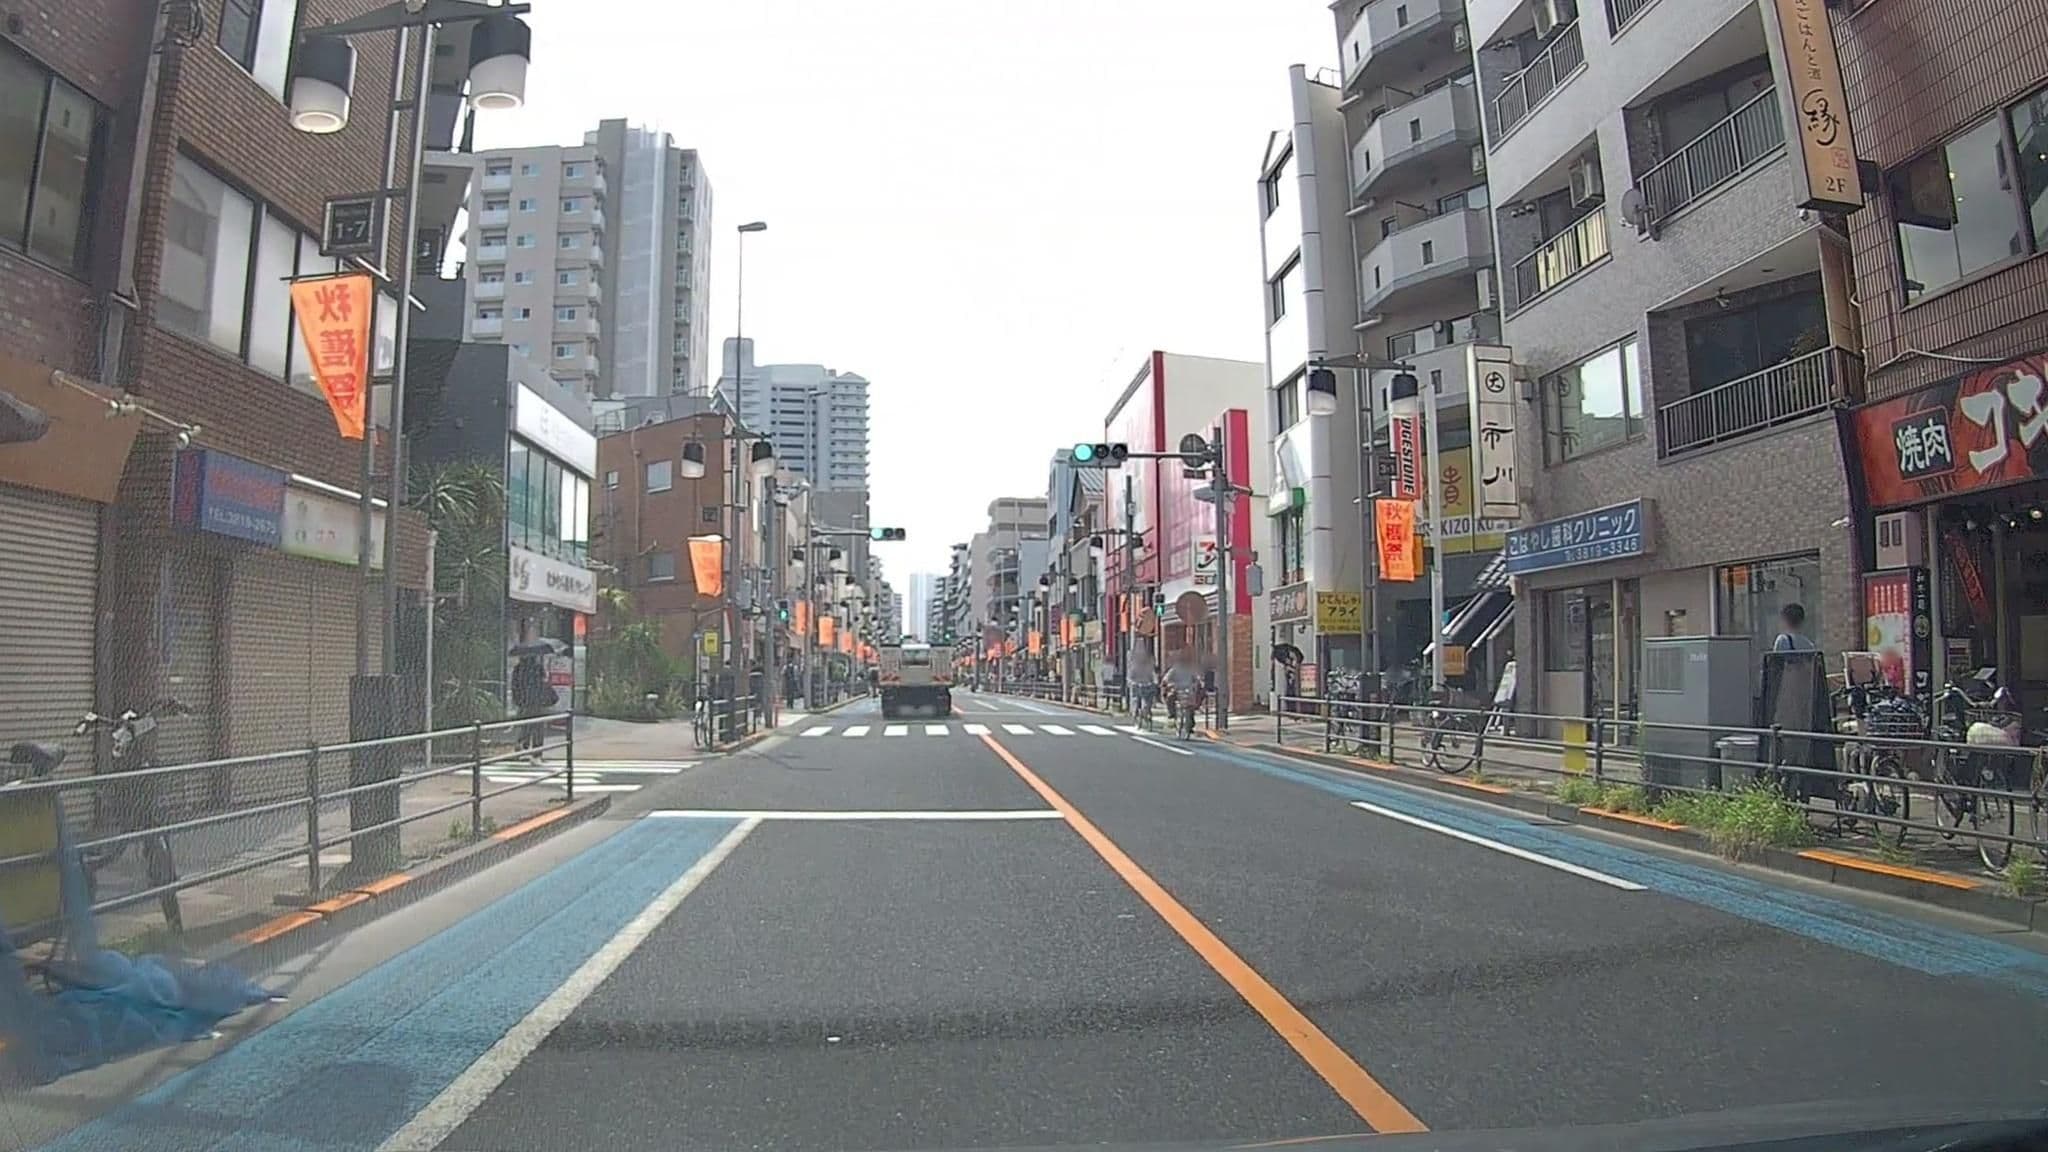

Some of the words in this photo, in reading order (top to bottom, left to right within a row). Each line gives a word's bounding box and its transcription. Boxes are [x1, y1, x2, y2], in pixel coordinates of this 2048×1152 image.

[1825, 176, 1847, 193] 2F
[336, 220, 367, 242] 1-7
[1481, 421, 1514, 486] 市川
[1896, 419, 1951, 472] 焼肉
[1510, 508, 1636, 556] こばやし歯科クリニック
